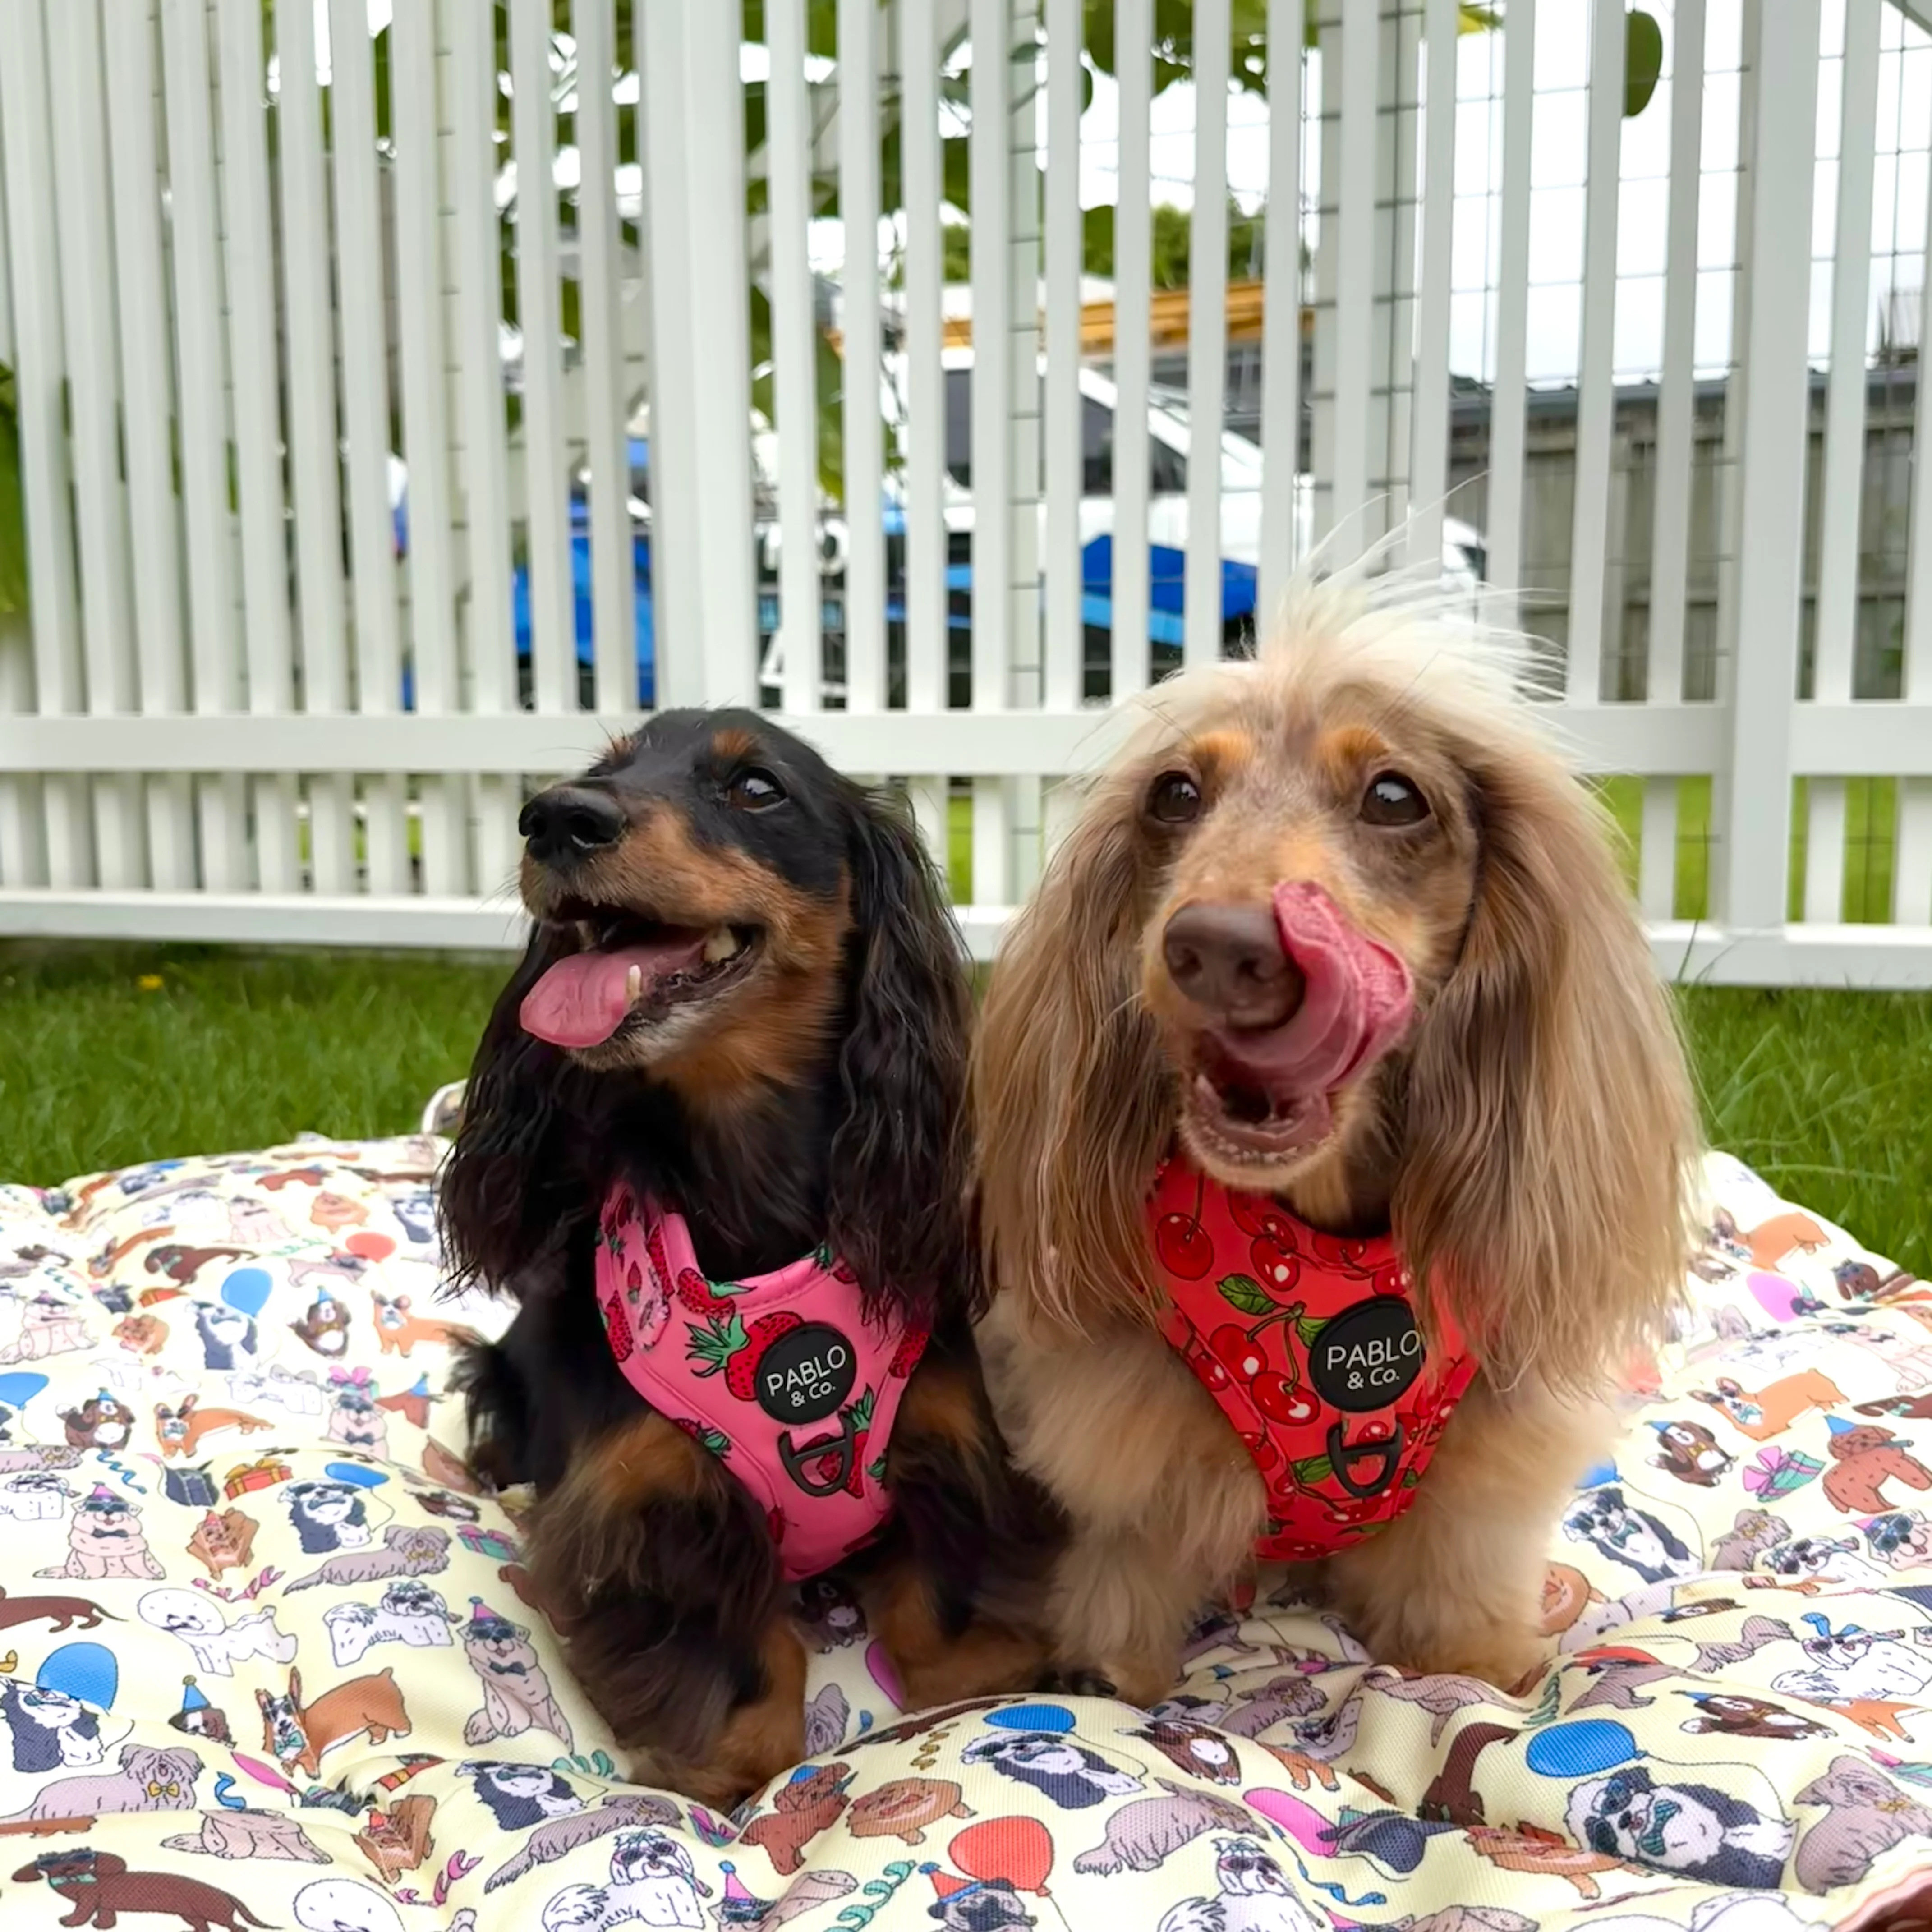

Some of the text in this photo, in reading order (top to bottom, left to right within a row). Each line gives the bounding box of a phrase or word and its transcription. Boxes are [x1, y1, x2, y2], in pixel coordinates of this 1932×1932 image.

[1327, 1330, 1420, 1370] PABLO
[767, 1345, 846, 1396] PABLO
[1347, 1371, 1364, 1389] &
[791, 1391, 805, 1407] &
